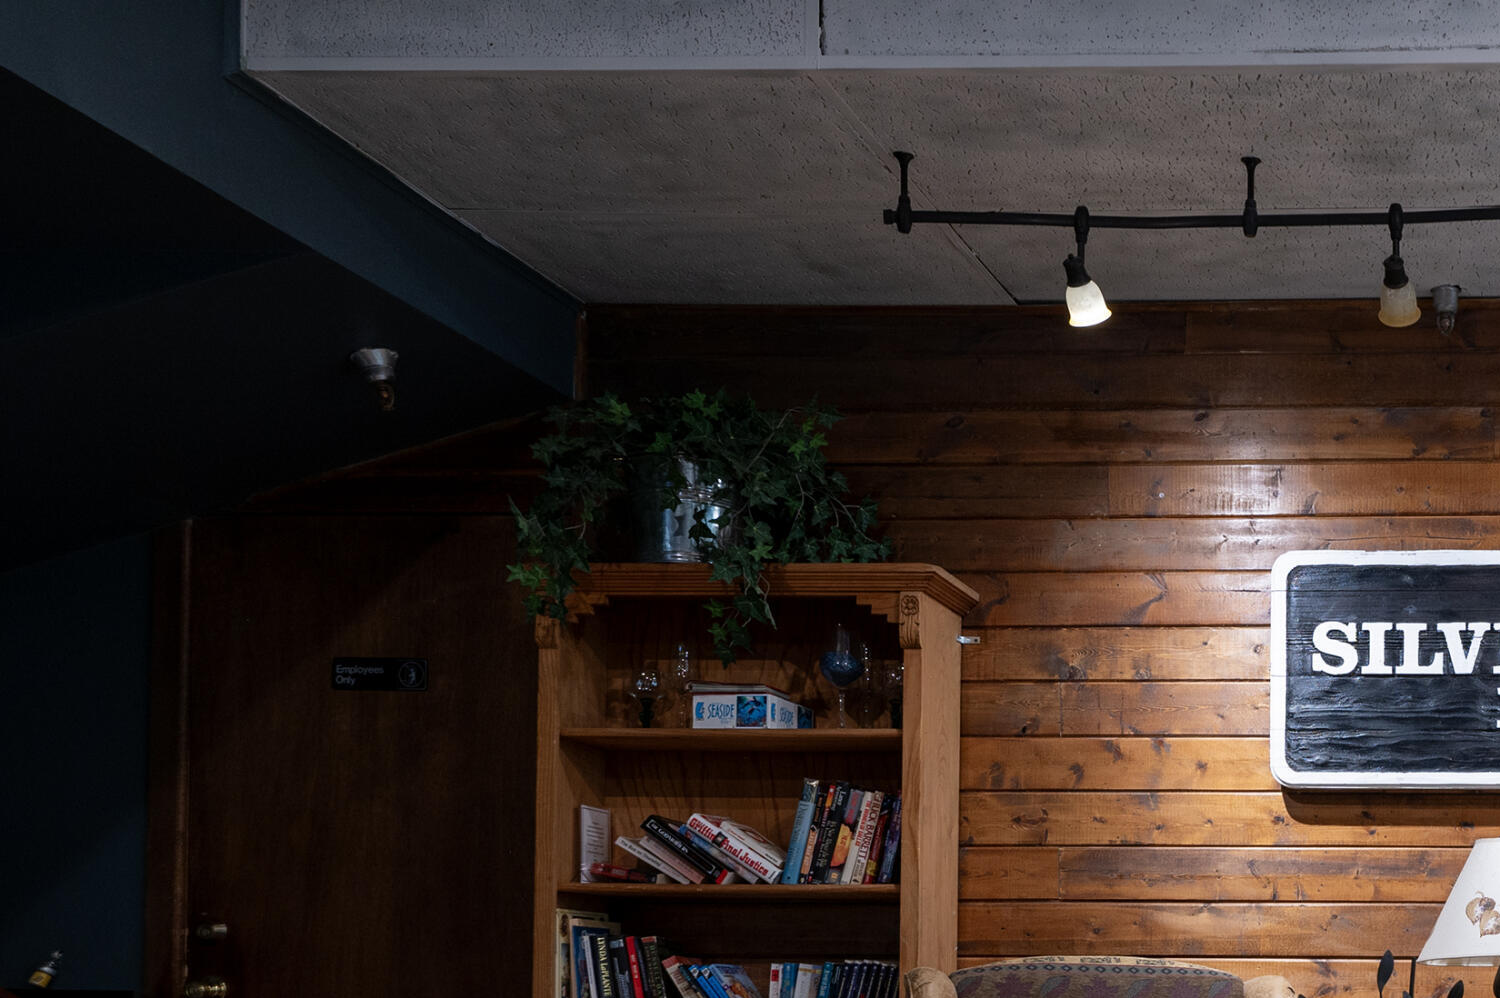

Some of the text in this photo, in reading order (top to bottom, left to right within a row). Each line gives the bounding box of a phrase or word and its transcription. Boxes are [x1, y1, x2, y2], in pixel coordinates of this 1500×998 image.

[336, 664, 385, 676] Employees
[336, 675, 357, 686] Only
[707, 703, 735, 719] SEASIDE
[688, 816, 718, 841] Griffin
[858, 823, 874, 859] BARRETT
[719, 837, 770, 877] Final Justice
[596, 936, 608, 961] LYNDA
